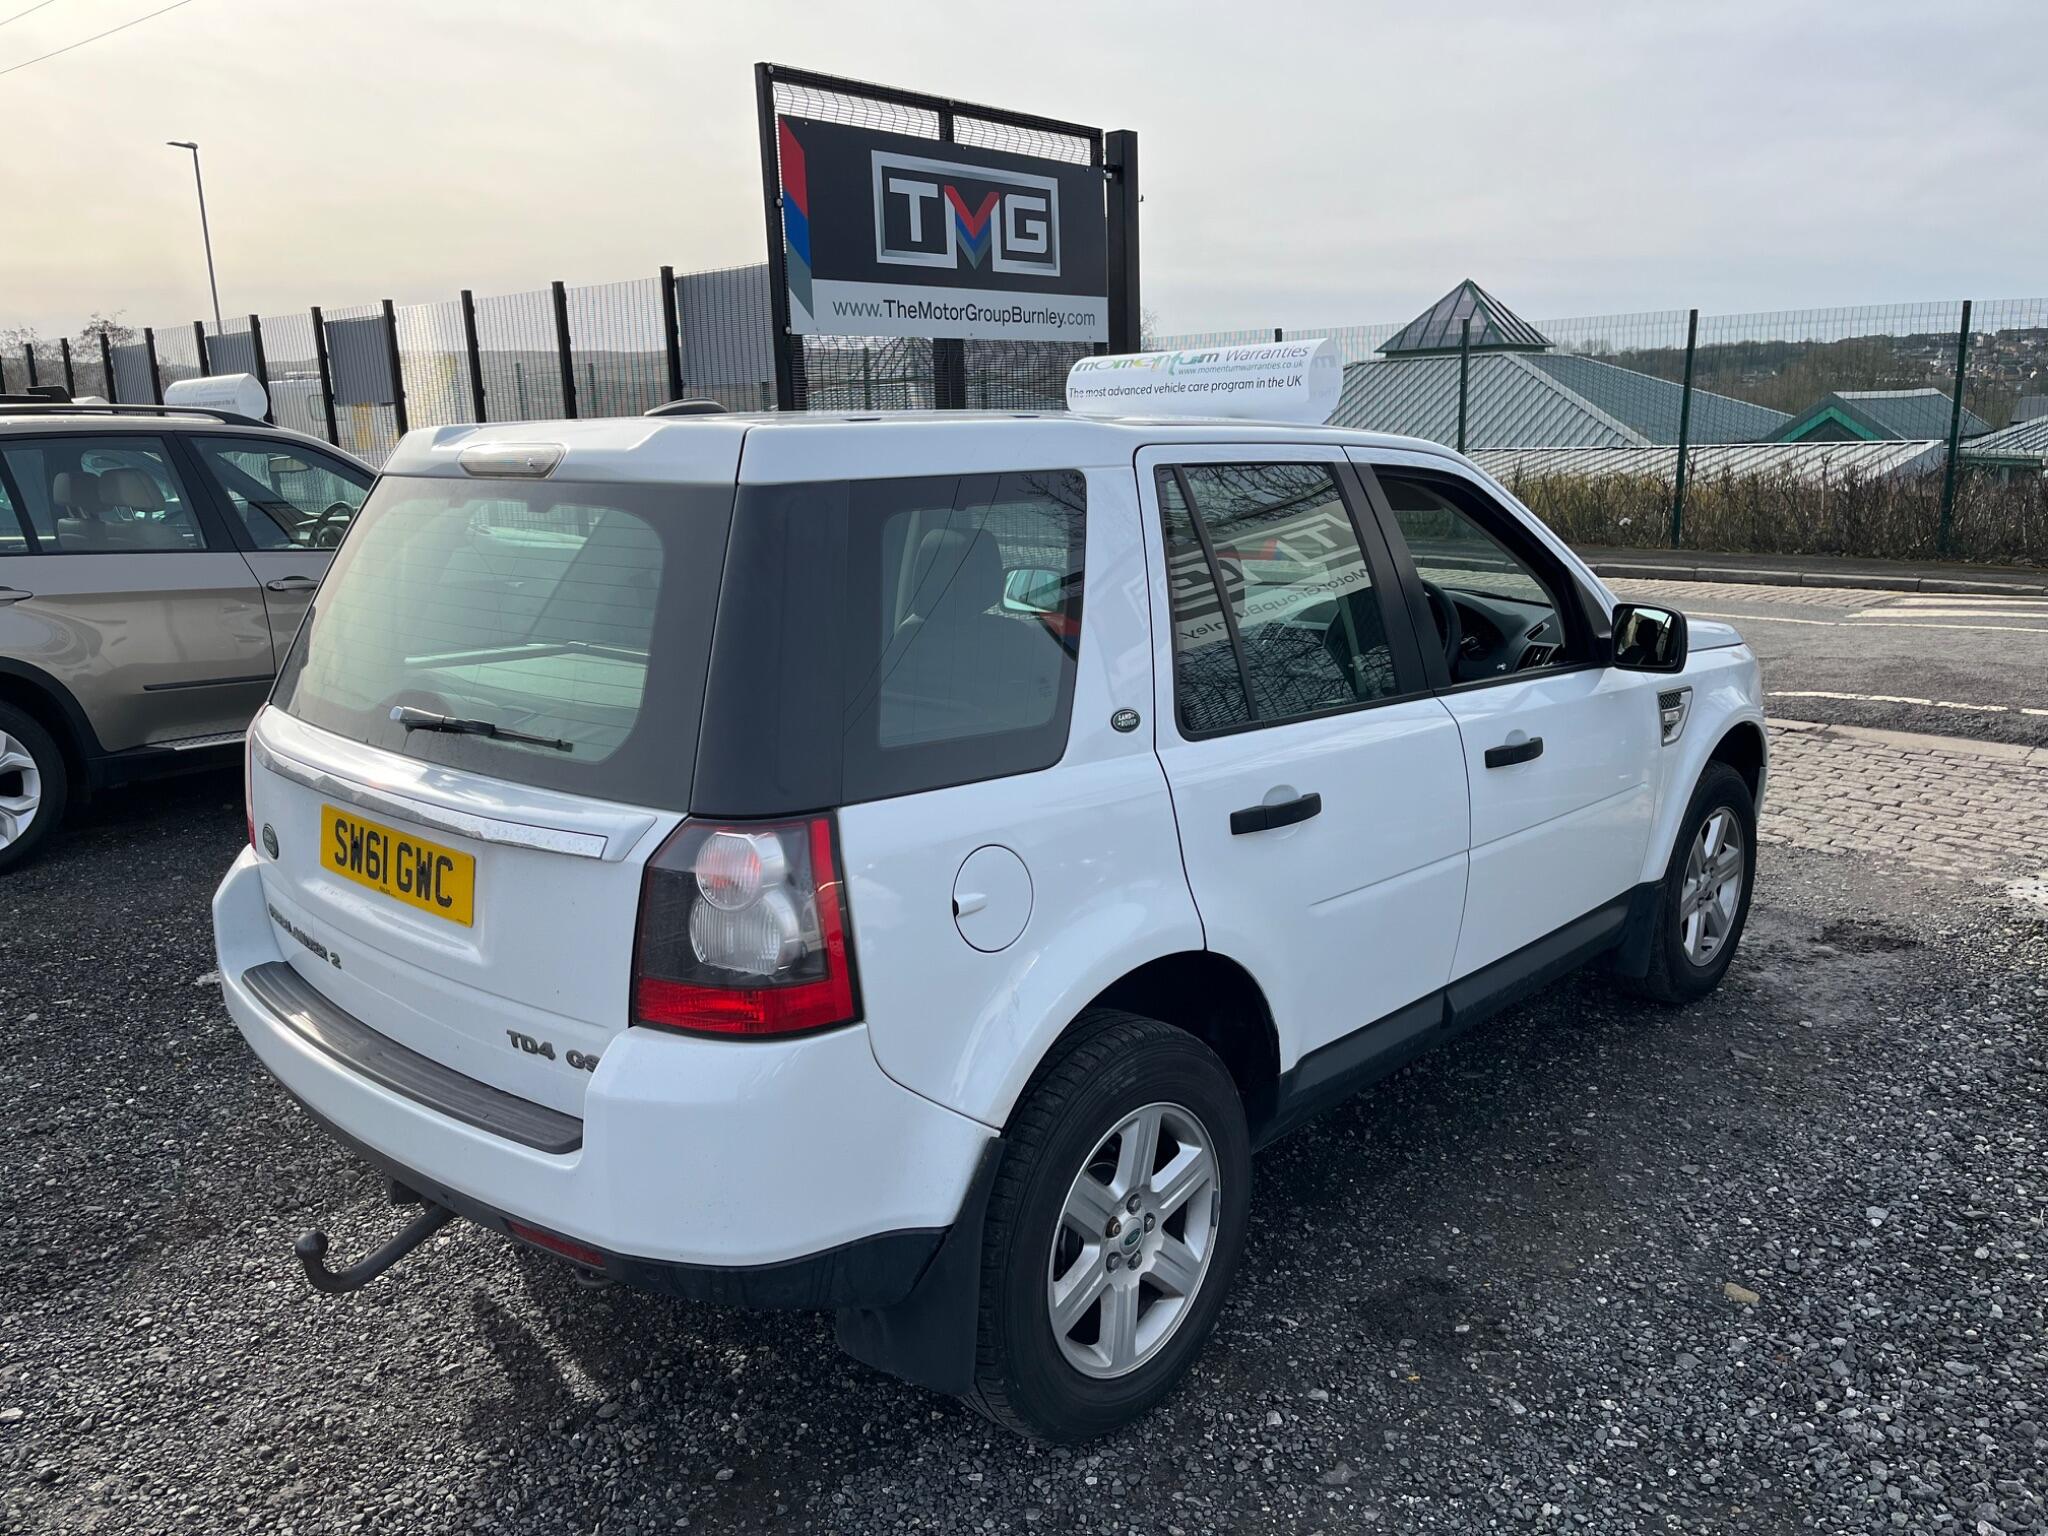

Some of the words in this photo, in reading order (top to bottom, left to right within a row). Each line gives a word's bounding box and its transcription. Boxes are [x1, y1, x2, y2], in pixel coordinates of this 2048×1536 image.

[889, 177, 1048, 271] TMG
[832, 299, 1096, 328] www.TheMotorGroupBurnley.com
[1225, 344, 1310, 362] Warranties
[1069, 387, 1084, 399] The
[1086, 386, 1106, 398] most
[1108, 384, 1152, 397] advanced
[1154, 381, 1186, 394] vehicle
[1188, 382, 1209, 393] care
[1211, 379, 1255, 393] program
[1256, 377, 1266, 389] in
[1268, 376, 1285, 388] the
[1286, 374, 1302, 387] UK
[335, 818, 389, 885] SW61
[396, 842, 454, 909] GWC
[506, 1029, 556, 1061] TD4
